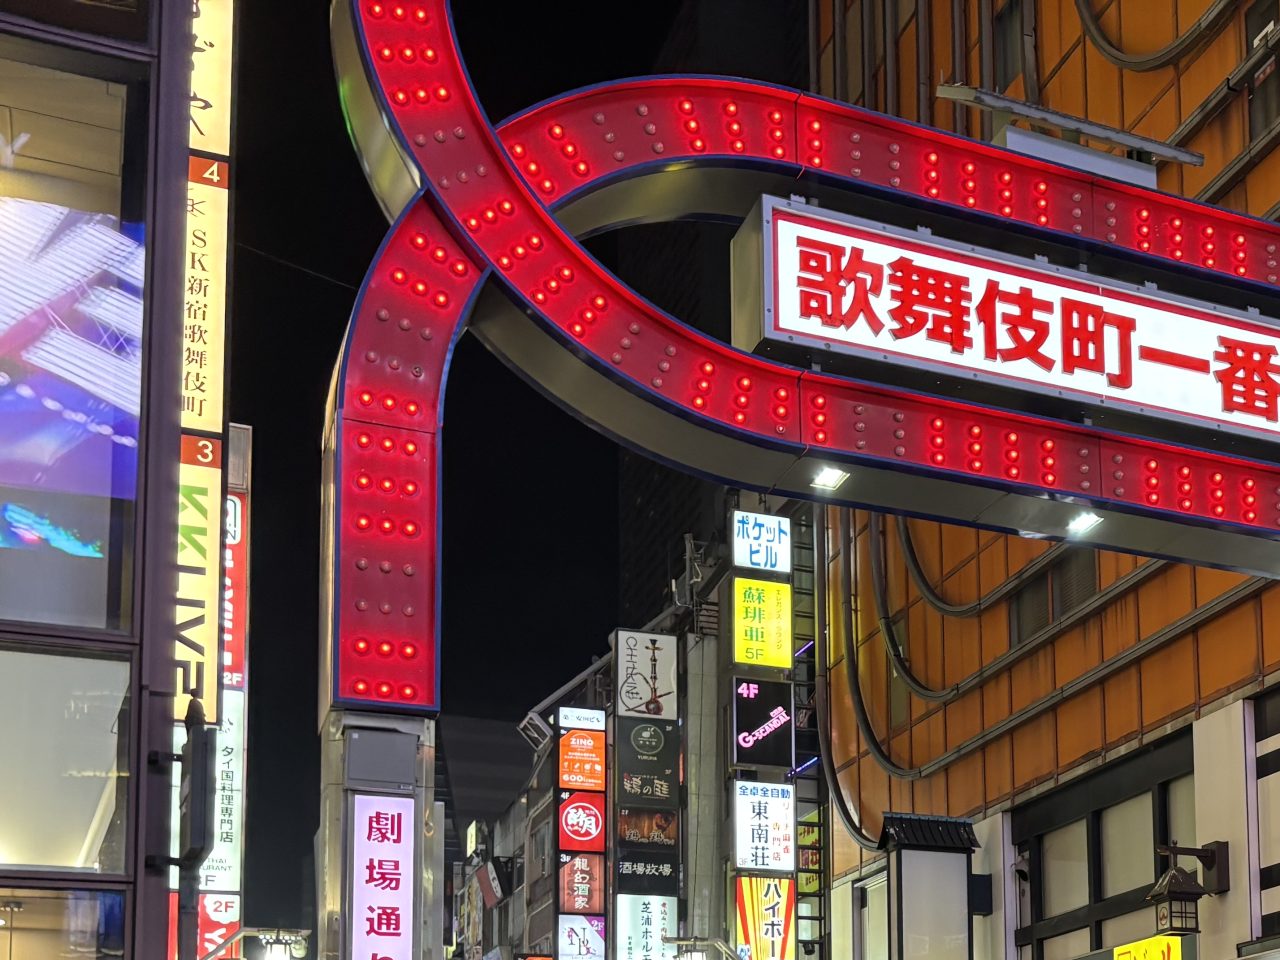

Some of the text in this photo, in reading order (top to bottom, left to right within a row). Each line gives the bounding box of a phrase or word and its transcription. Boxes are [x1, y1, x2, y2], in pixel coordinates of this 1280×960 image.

[202, 161, 220, 183] 4
[197, 440, 214, 463] 3
[737, 515, 788, 544] ポケット
[749, 543, 778, 569] ビル
[745, 647, 765, 660] 5F
[737, 682, 759, 699] 4F
[569, 736, 594, 747] ZINO
[220, 745, 234, 844] タイ国料理専門店
[738, 784, 791, 799] 全卓全自動
[750, 800, 770, 867] 東南荘
[618, 861, 673, 876] 酒場牧場
[212, 900, 235, 914] 2F
